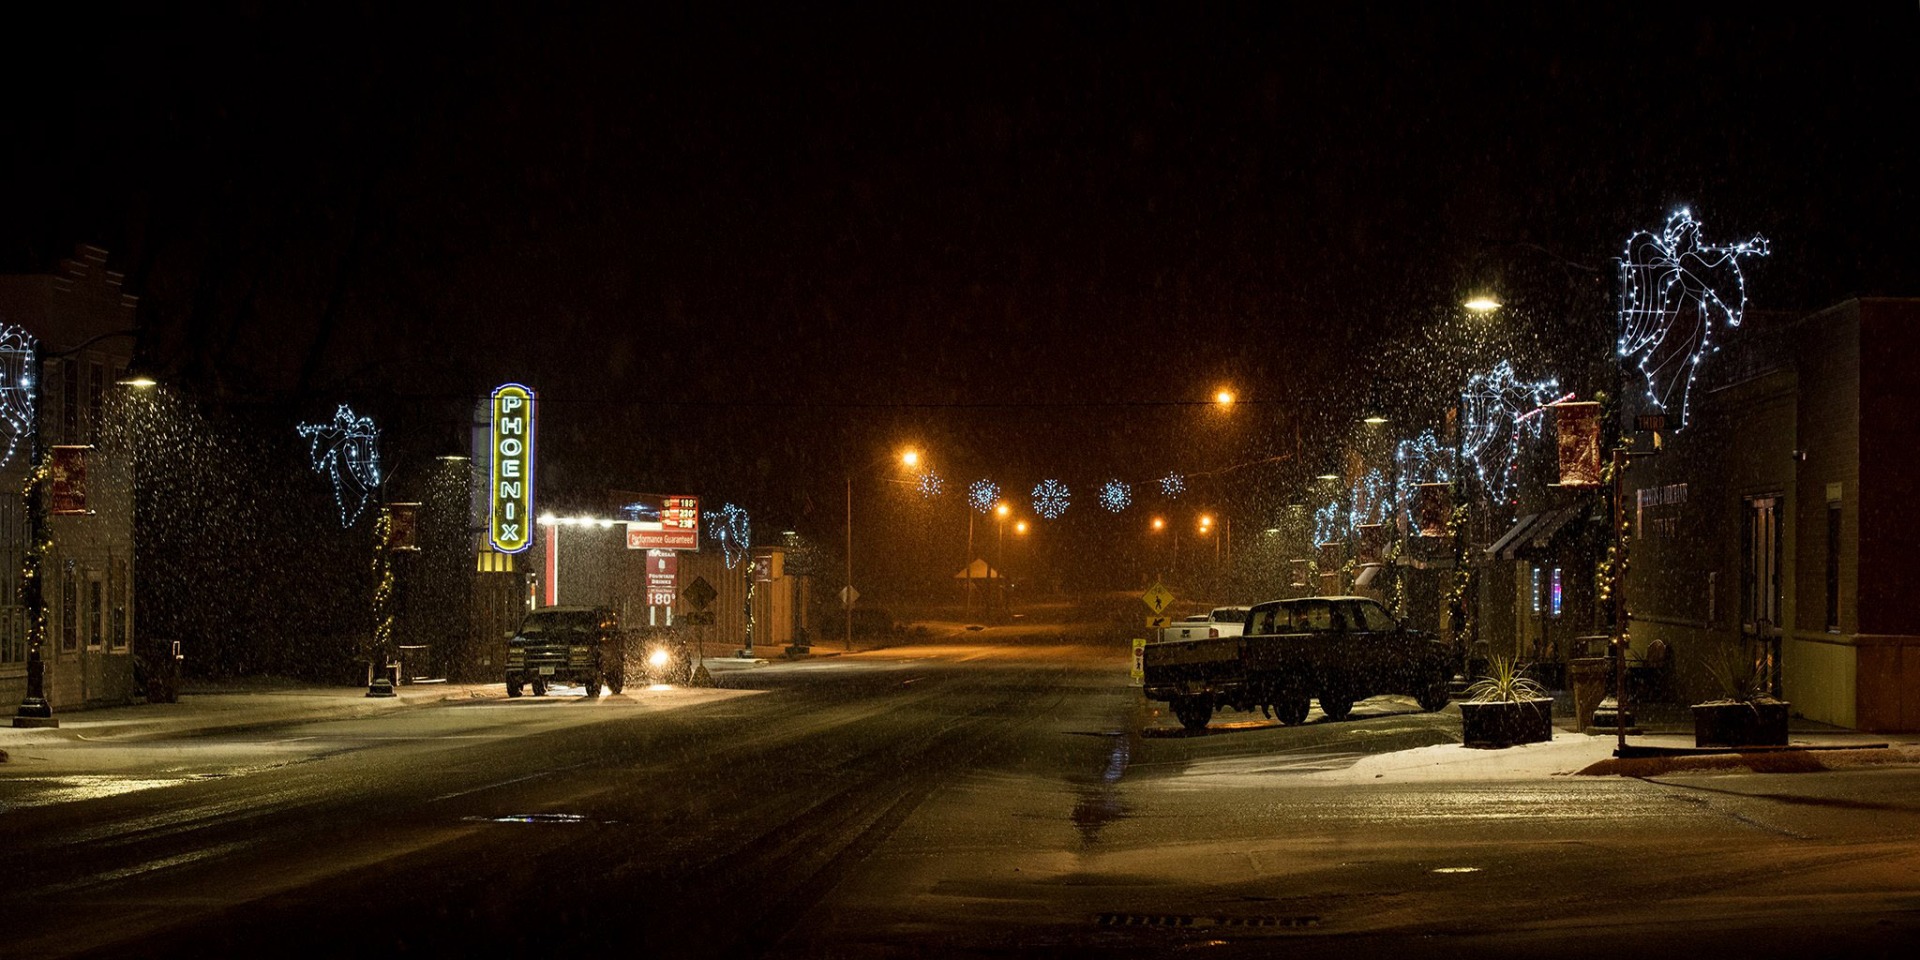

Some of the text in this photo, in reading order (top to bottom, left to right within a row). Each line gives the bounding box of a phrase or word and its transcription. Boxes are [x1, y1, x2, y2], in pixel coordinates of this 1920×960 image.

[1637, 415, 1665, 429] THIRD
[500, 396, 522, 541] PHOENIX
[631, 534, 694, 545] Performance Guaranteed
